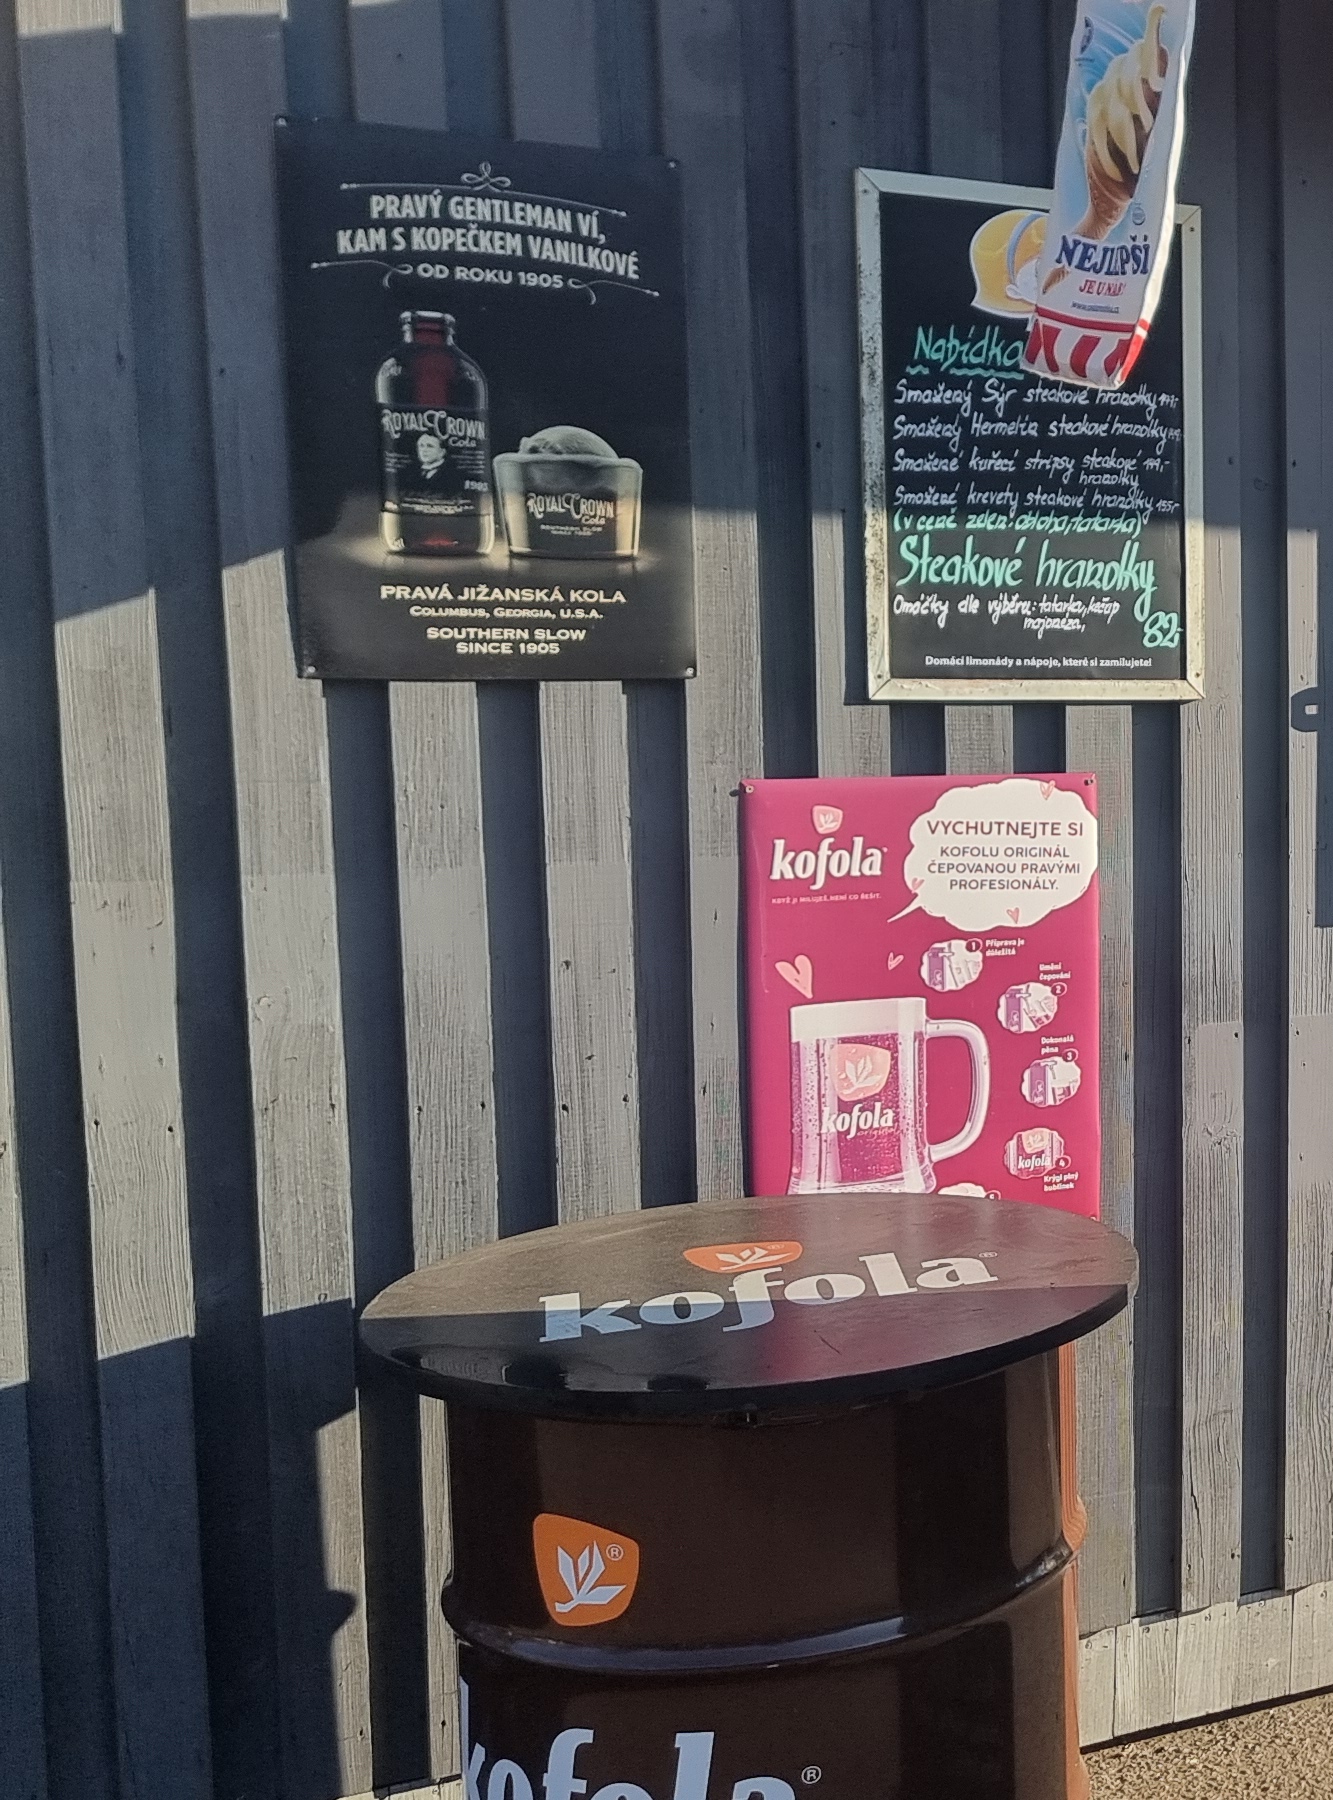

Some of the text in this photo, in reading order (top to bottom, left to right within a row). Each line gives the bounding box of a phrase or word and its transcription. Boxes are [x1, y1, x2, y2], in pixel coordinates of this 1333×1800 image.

[370, 189, 606, 244] PRAVÝ GENTLEMAN VÍ,
[337, 222, 639, 279] KAM S KOPEČKEM VANILKOVÉ
[417, 263, 563, 288] OD ROKU 1905
[912, 324, 1024, 371] Nabídka
[896, 534, 1158, 622] Steakové hranolky
[381, 583, 626, 603] PRAVÁ JIŽANSKÁ KOLA
[560, 608, 603, 619] U.S.A.
[894, 594, 980, 628] Omáčky dle
[427, 627, 586, 641] SOUTHERN SLOW
[457, 642, 560, 654] SINCE 1905
[926, 656, 964, 666] Domácí
[966, 656, 1013, 668] limonády
[1024, 657, 1060, 668] nápoje,
[1063, 657, 1088, 667] které
[1090, 658, 1098, 667] si
[927, 821, 1083, 838] VYCHUTNEJTE SI
[940, 844, 1070, 858] KOFOLU ORIGINÁL
[770, 836, 881, 890] kofola
[927, 859, 1080, 874] ČEPOVANOU PRAVÝMI
[950, 877, 1059, 890] PROFESIONÁLY.
[971, 942, 975, 950] 1
[821, 1102, 894, 1139] kofola
[1018, 1154, 1051, 1171] kofola
[539, 1252, 999, 1343] kofola
